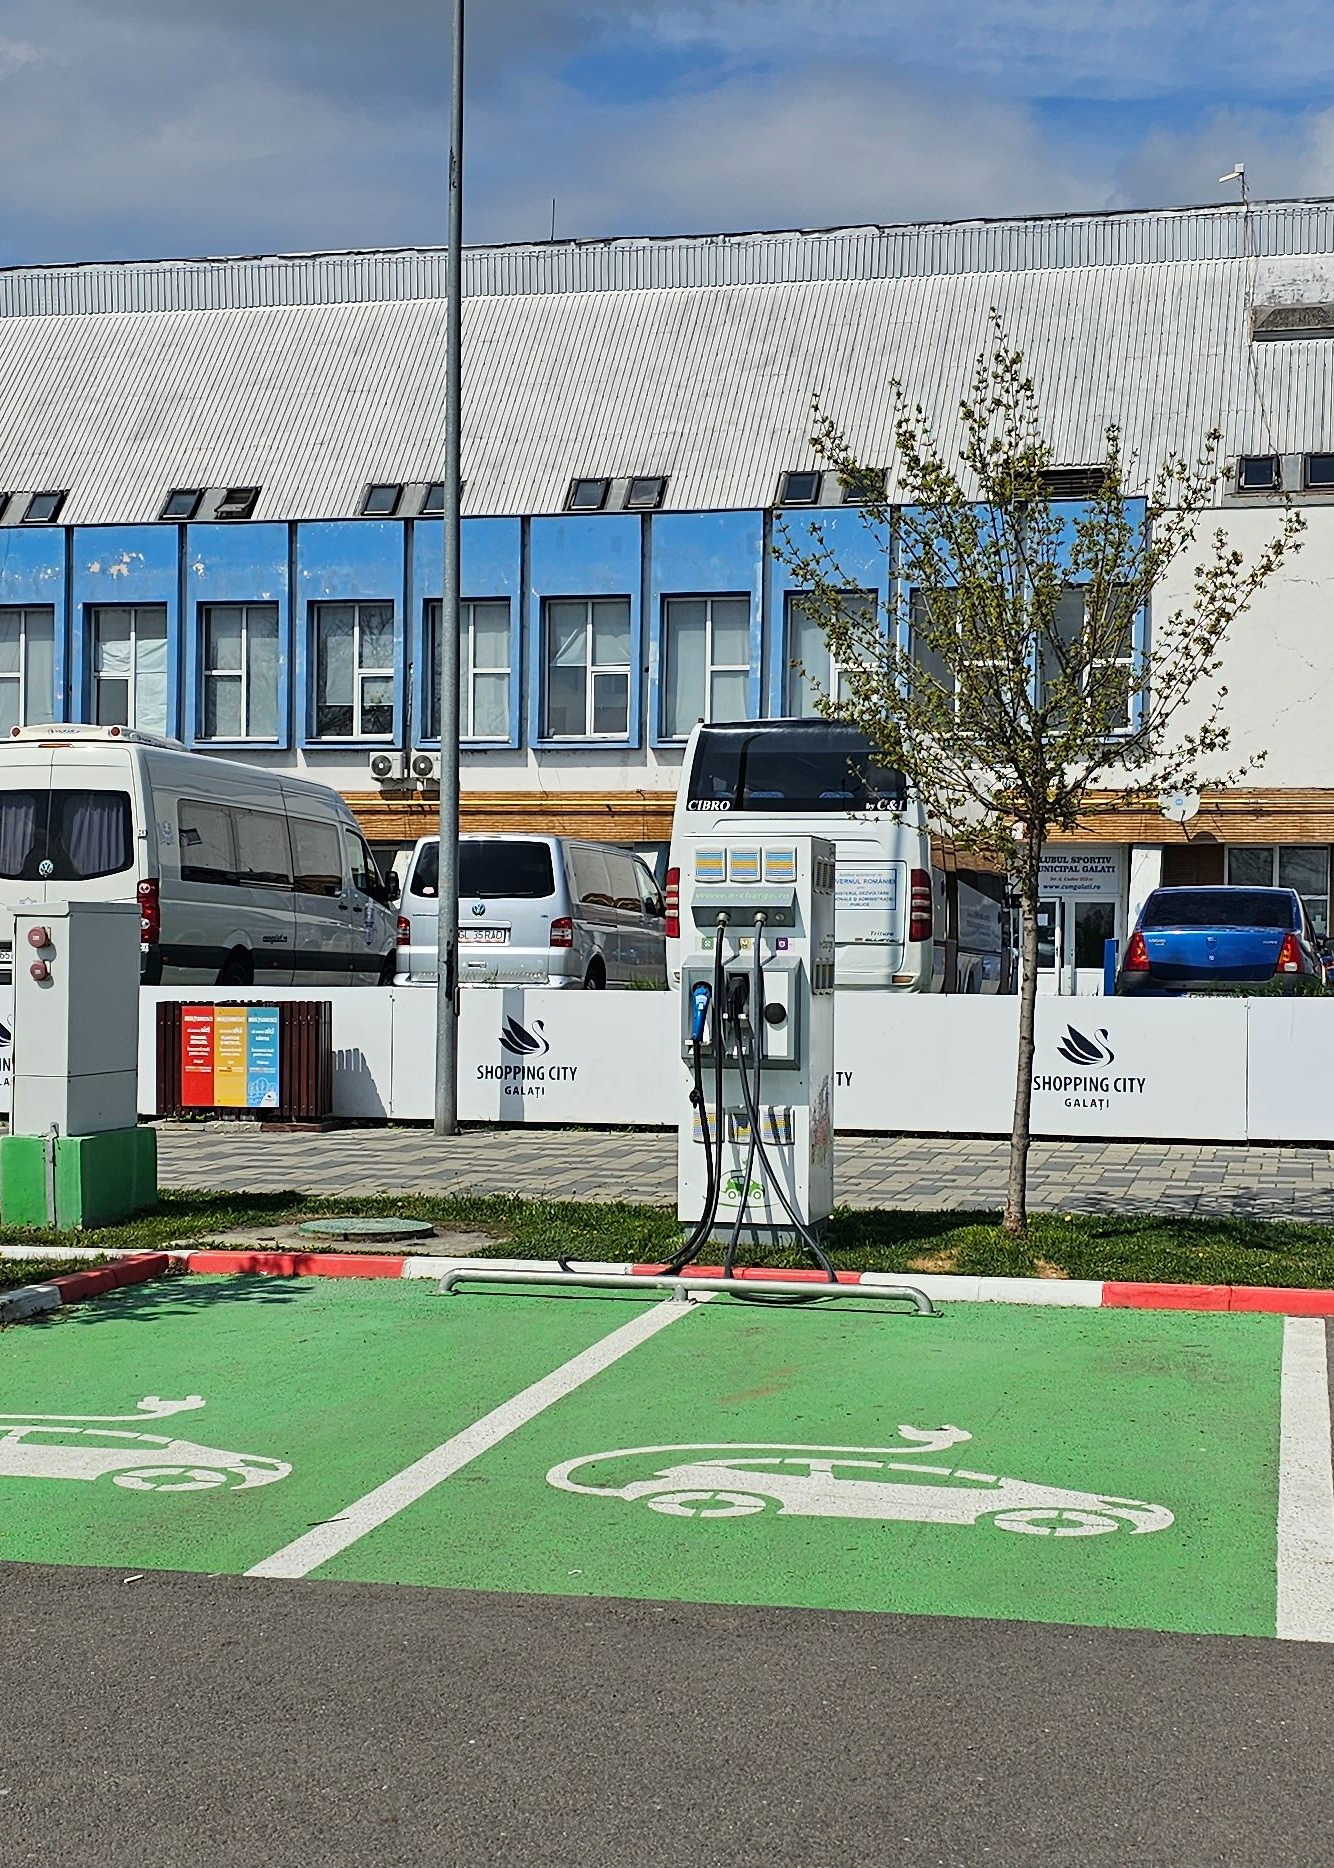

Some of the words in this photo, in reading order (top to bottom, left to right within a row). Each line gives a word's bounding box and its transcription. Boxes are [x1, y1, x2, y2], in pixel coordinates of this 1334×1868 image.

[688, 800, 730, 811] CIBRO
[1039, 856, 1069, 864] LUBUL
[1071, 856, 1112, 864] SPORTIV
[1038, 865, 1080, 873] UNICIPAL
[1082, 865, 1115, 873] GALATI
[477, 1065, 545, 1080] SHOPPING
[549, 1066, 577, 1081] CITY
[835, 1071, 853, 1087] TY
[1033, 1075, 1109, 1092] SHOPPING
[1113, 1077, 1146, 1093] CITY
